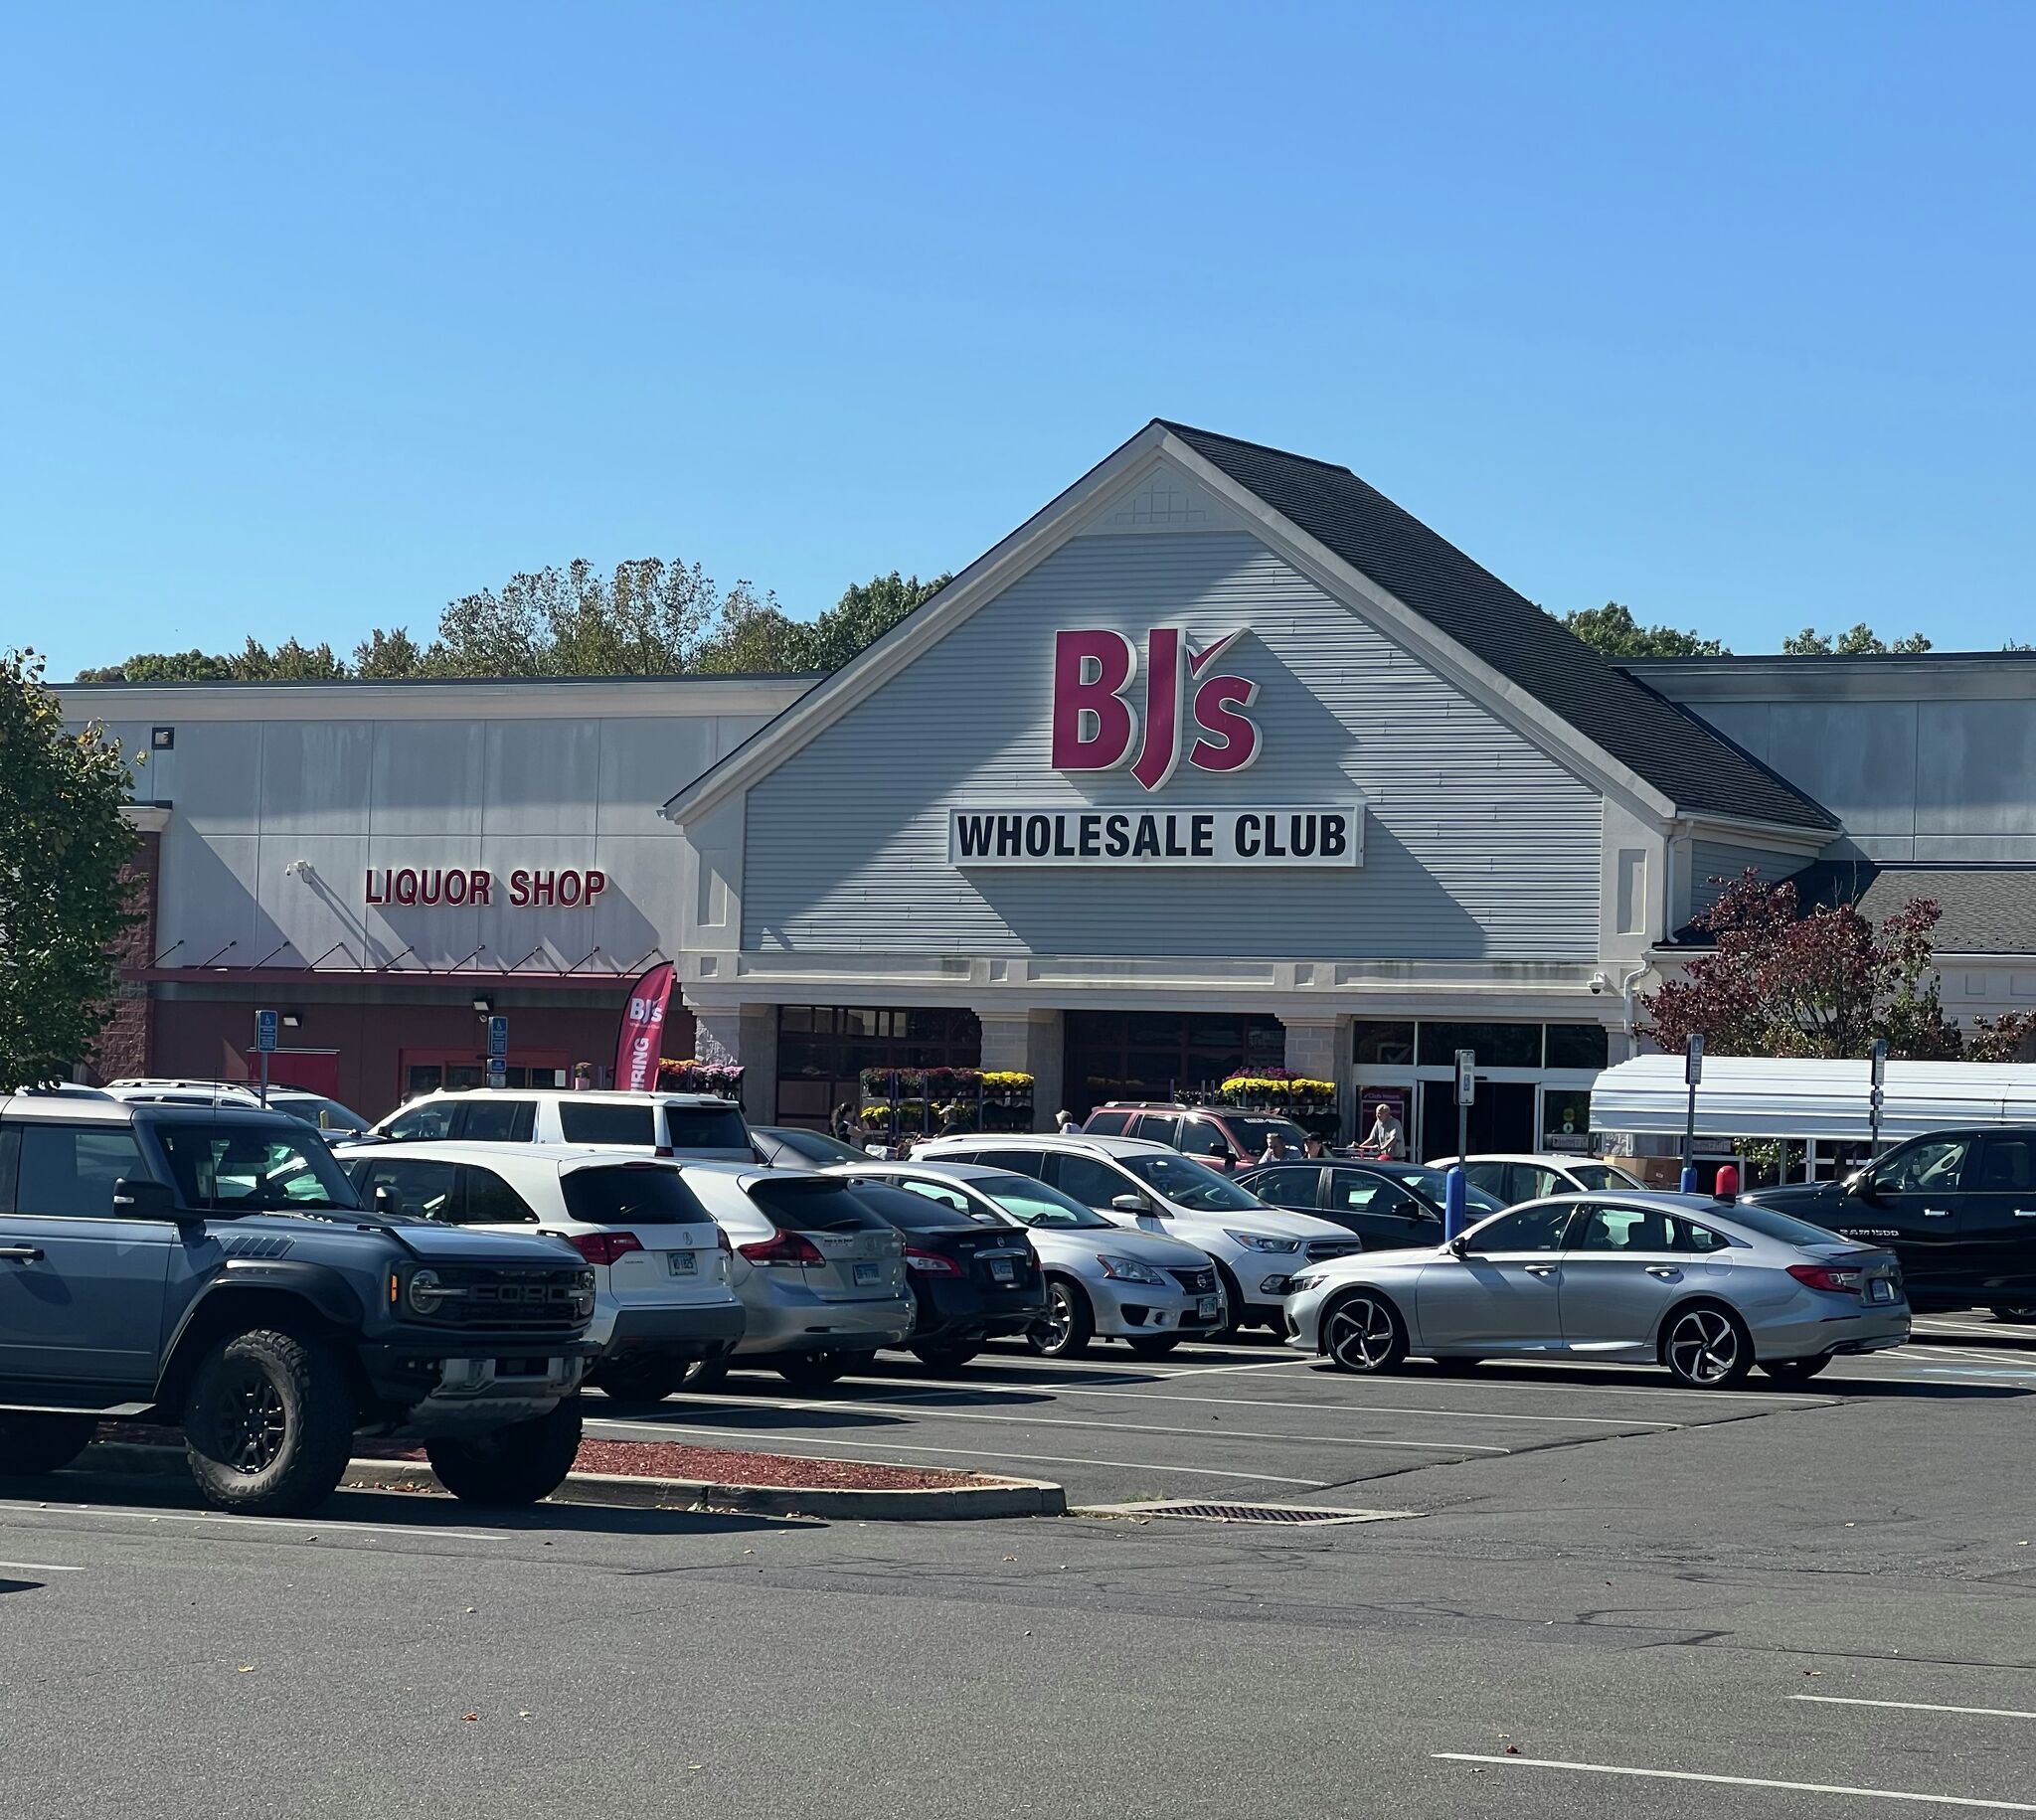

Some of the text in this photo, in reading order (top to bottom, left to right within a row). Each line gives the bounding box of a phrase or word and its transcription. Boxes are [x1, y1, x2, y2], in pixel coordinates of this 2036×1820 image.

[1051, 627, 1263, 792] BJ's
[956, 812, 1348, 858] WHOLESALE CLUB
[365, 868, 606, 908] LIQUOR SHOP
[629, 997, 664, 1025] BJ's
[630, 1037, 649, 1091] IRING
[471, 1283, 574, 1304] FORD
